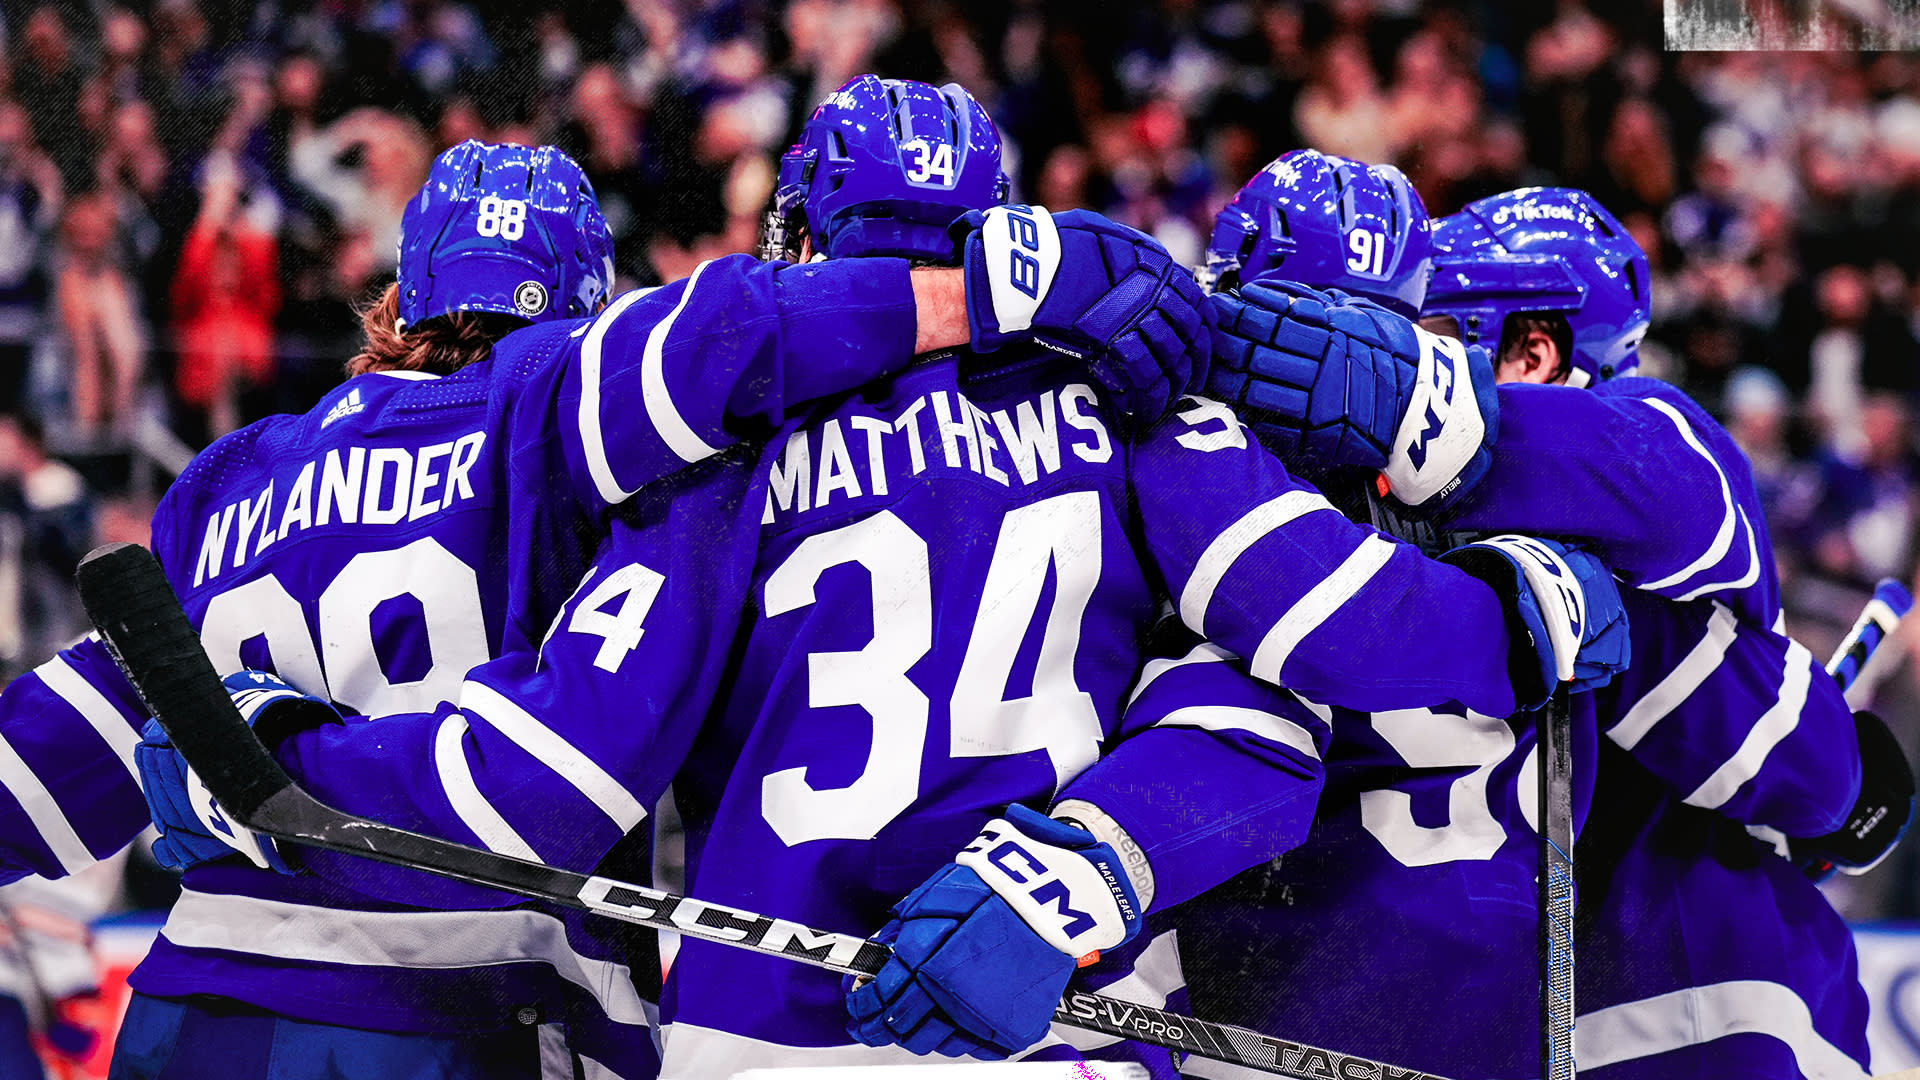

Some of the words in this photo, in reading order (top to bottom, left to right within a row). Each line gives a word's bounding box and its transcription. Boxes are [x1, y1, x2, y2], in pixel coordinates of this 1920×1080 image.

[907, 138, 954, 186] 34
[476, 195, 527, 241] 88
[1347, 227, 1385, 276] 91
[320, 402, 366, 430] adidas
[1406, 337, 1455, 473] CM
[760, 383, 1114, 526] MATTHEWS
[192, 430, 488, 589] NYLANDER
[1439, 476, 1462, 499] RIELLY
[761, 490, 1106, 849] 34
[1097, 861, 1120, 895] MAPLE
[1115, 894, 1136, 922] LEAFS
[1111, 824, 1152, 900] Reebok
[576, 875, 867, 968] CCM
[1134, 1018, 1184, 1041] PRO
